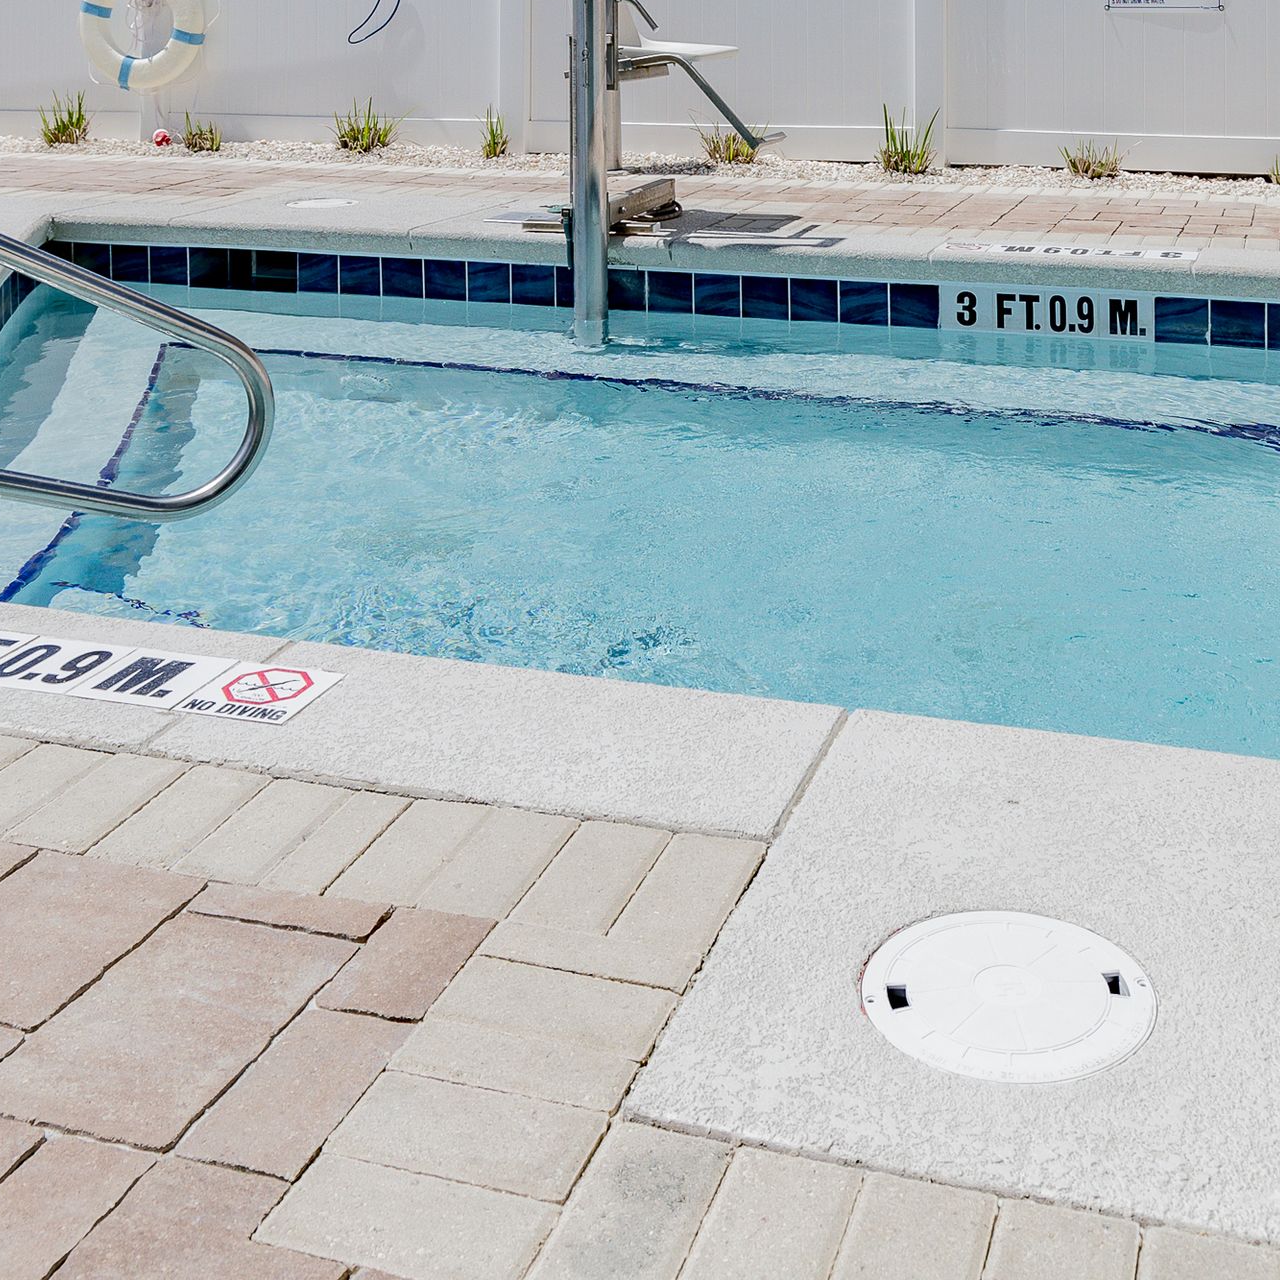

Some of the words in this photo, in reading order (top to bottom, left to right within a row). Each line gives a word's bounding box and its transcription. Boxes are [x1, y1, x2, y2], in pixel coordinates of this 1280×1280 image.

[956, 291, 976, 326] 3
[996, 293, 1041, 330] FT.
[1049, 295, 1094, 334] 0.9
[1109, 298, 1146, 336] M.
[92, 656, 196, 698] M.
[182, 698, 216, 711] NO
[215, 702, 288, 720] DIVING
